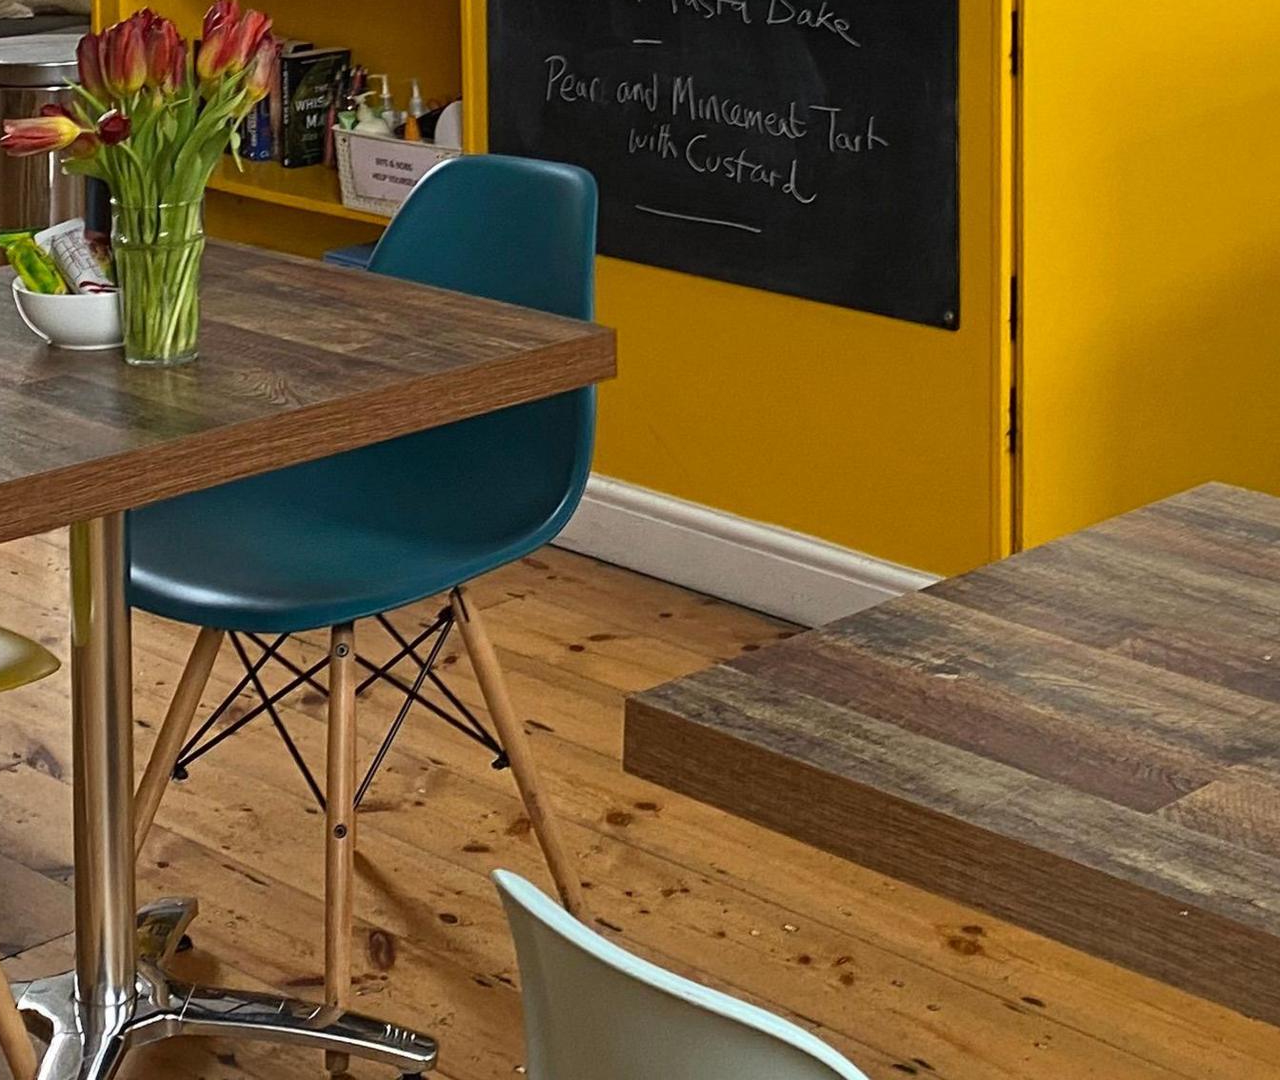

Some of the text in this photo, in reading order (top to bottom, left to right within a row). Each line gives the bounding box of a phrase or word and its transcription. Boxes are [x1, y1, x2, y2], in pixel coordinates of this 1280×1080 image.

[544, 54, 598, 102] Pear
[616, 73, 658, 112] and
[809, 102, 889, 152] Tart
[628, 124, 817, 204] with Custard
